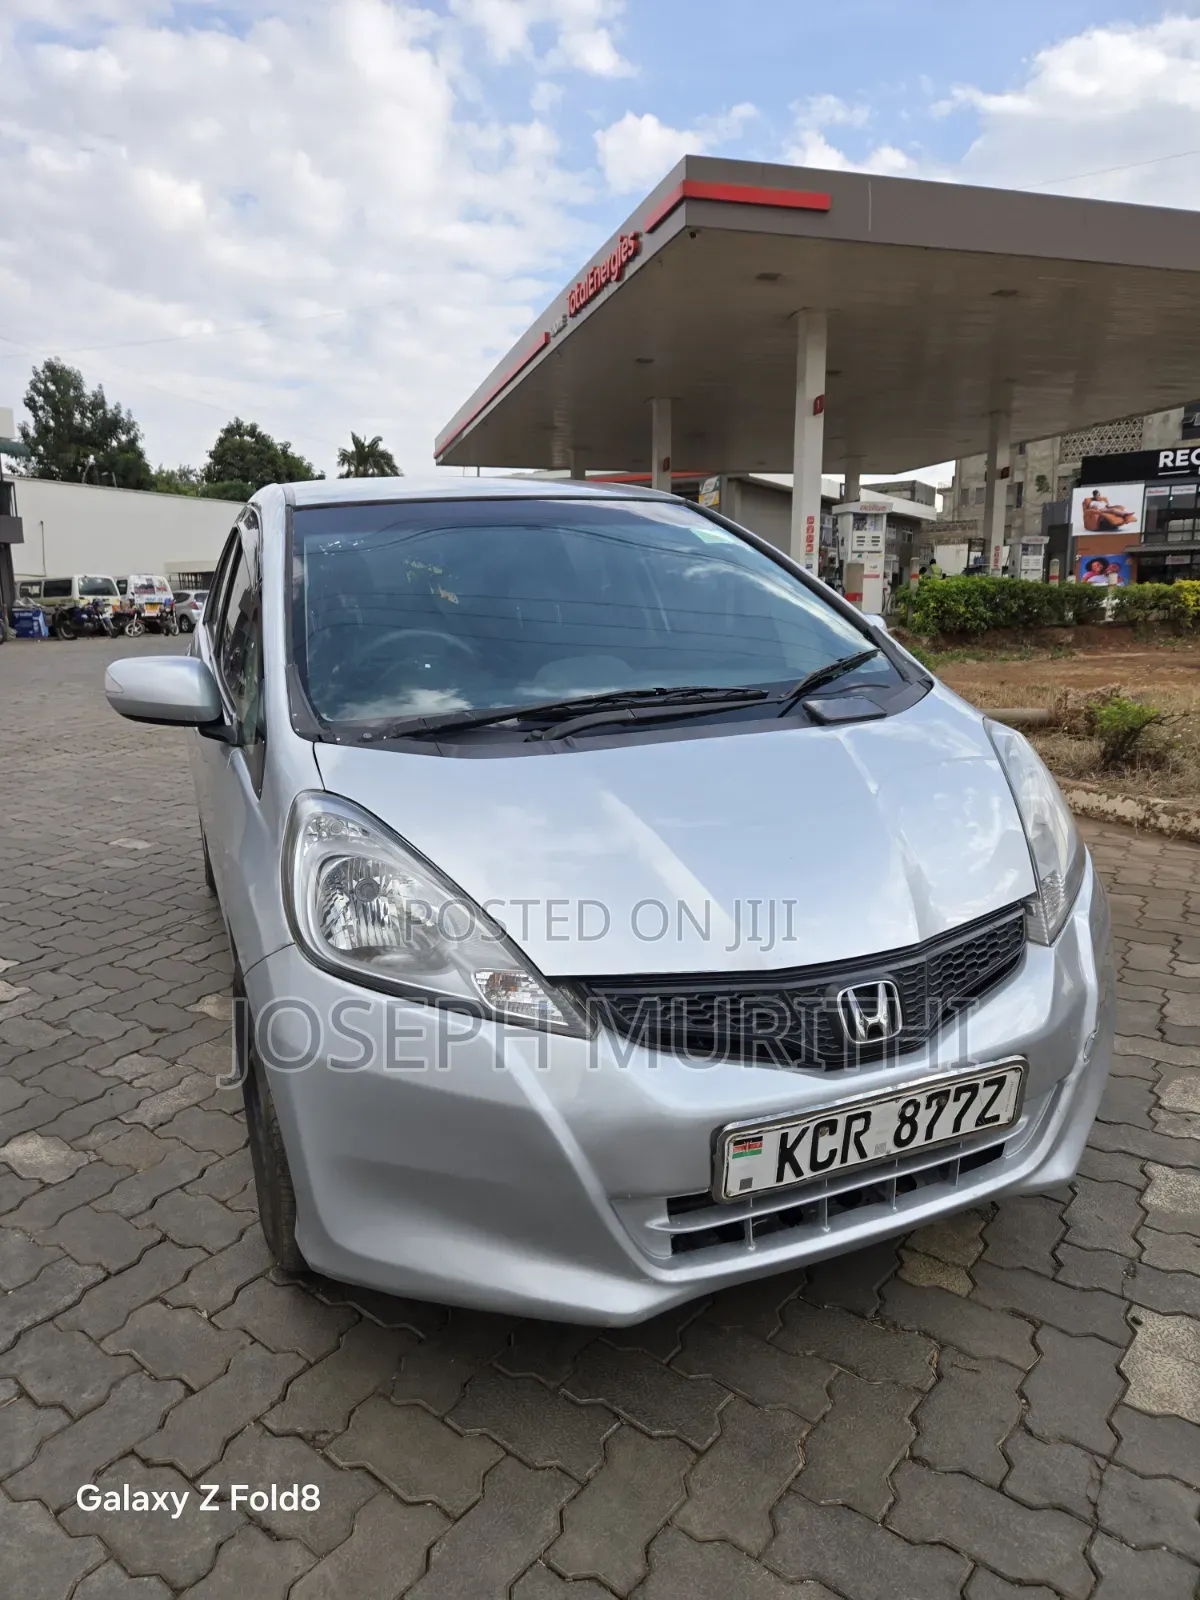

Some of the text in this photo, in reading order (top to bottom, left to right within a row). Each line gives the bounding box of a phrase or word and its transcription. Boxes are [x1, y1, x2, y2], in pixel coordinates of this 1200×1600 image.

[566, 231, 641, 318] TotalEnergies
[776, 1110, 871, 1183] KCR
[893, 1075, 1007, 1149] 877Z
